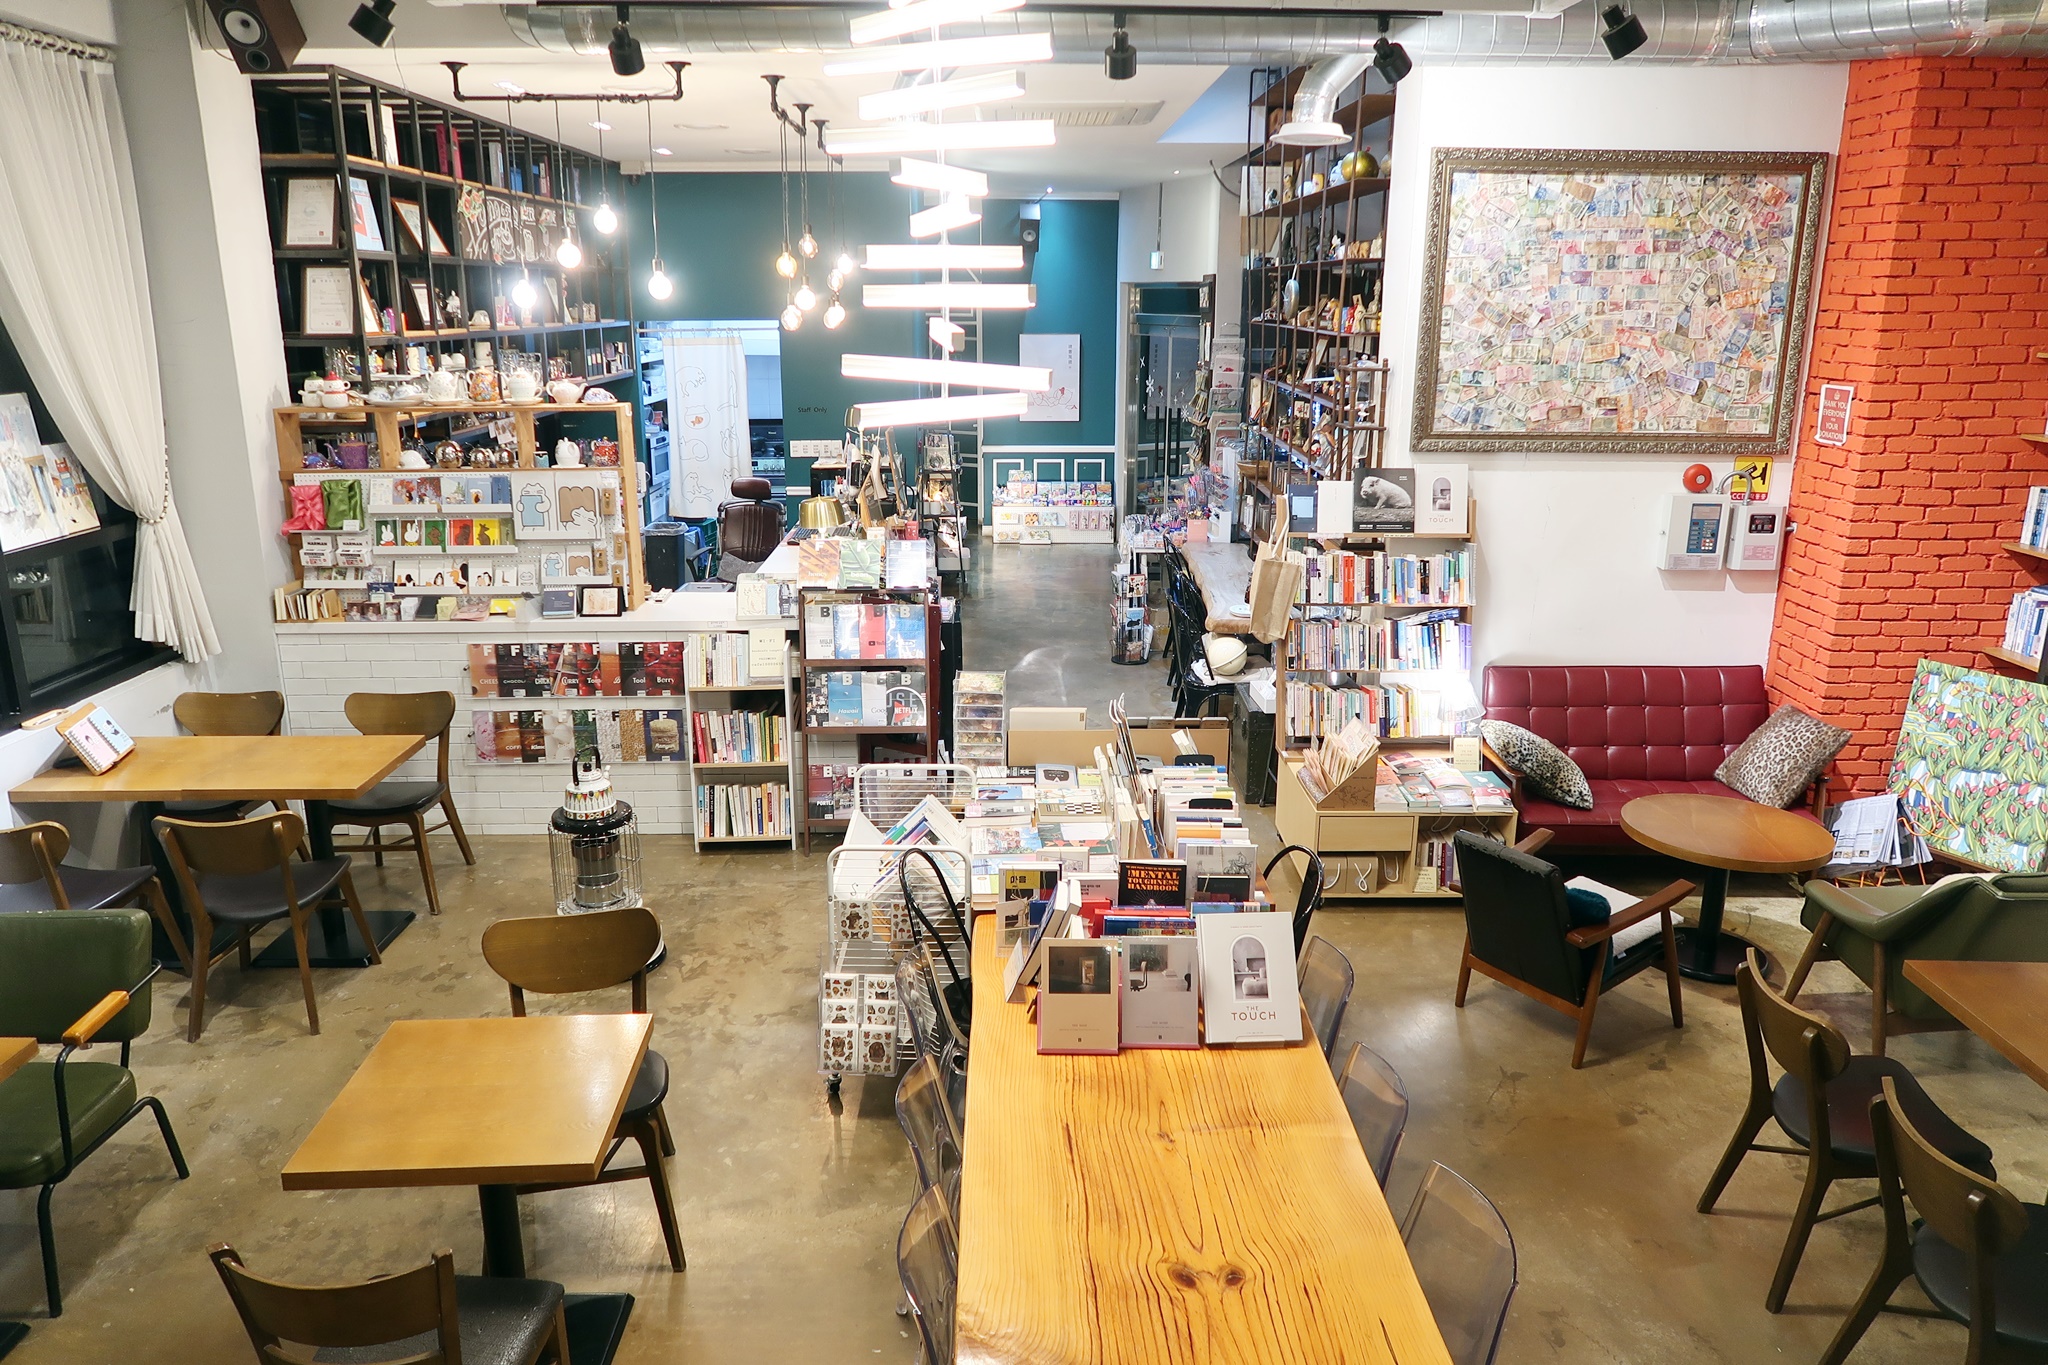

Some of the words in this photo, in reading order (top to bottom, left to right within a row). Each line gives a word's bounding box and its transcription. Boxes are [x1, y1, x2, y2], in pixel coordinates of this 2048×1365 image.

[1823, 409, 1845, 418] EVERYONE
[1825, 422, 1838, 430] YOUR
[814, 541, 823, 551] F
[820, 606, 830, 617] B
[899, 606, 910, 617] B
[483, 645, 492, 656] F
[510, 645, 520, 656] F
[538, 645, 547, 655] F
[563, 644, 572, 655] F
[592, 644, 599, 655] F
[634, 644, 643, 655] F
[659, 644, 668, 655] F
[842, 673, 852, 685] B
[901, 673, 911, 685] B
[509, 711, 518, 723] F
[533, 711, 542, 722] F
[587, 710, 595, 721] F
[611, 711, 619, 721] F
[635, 710, 642, 721] F
[823, 766, 832, 777] B
[847, 766, 856, 777] B
[1131, 869, 1179, 879] MENTAL
[1127, 883, 1178, 891] HANDBOOK
[1231, 1011, 1276, 1020] TOUCH
